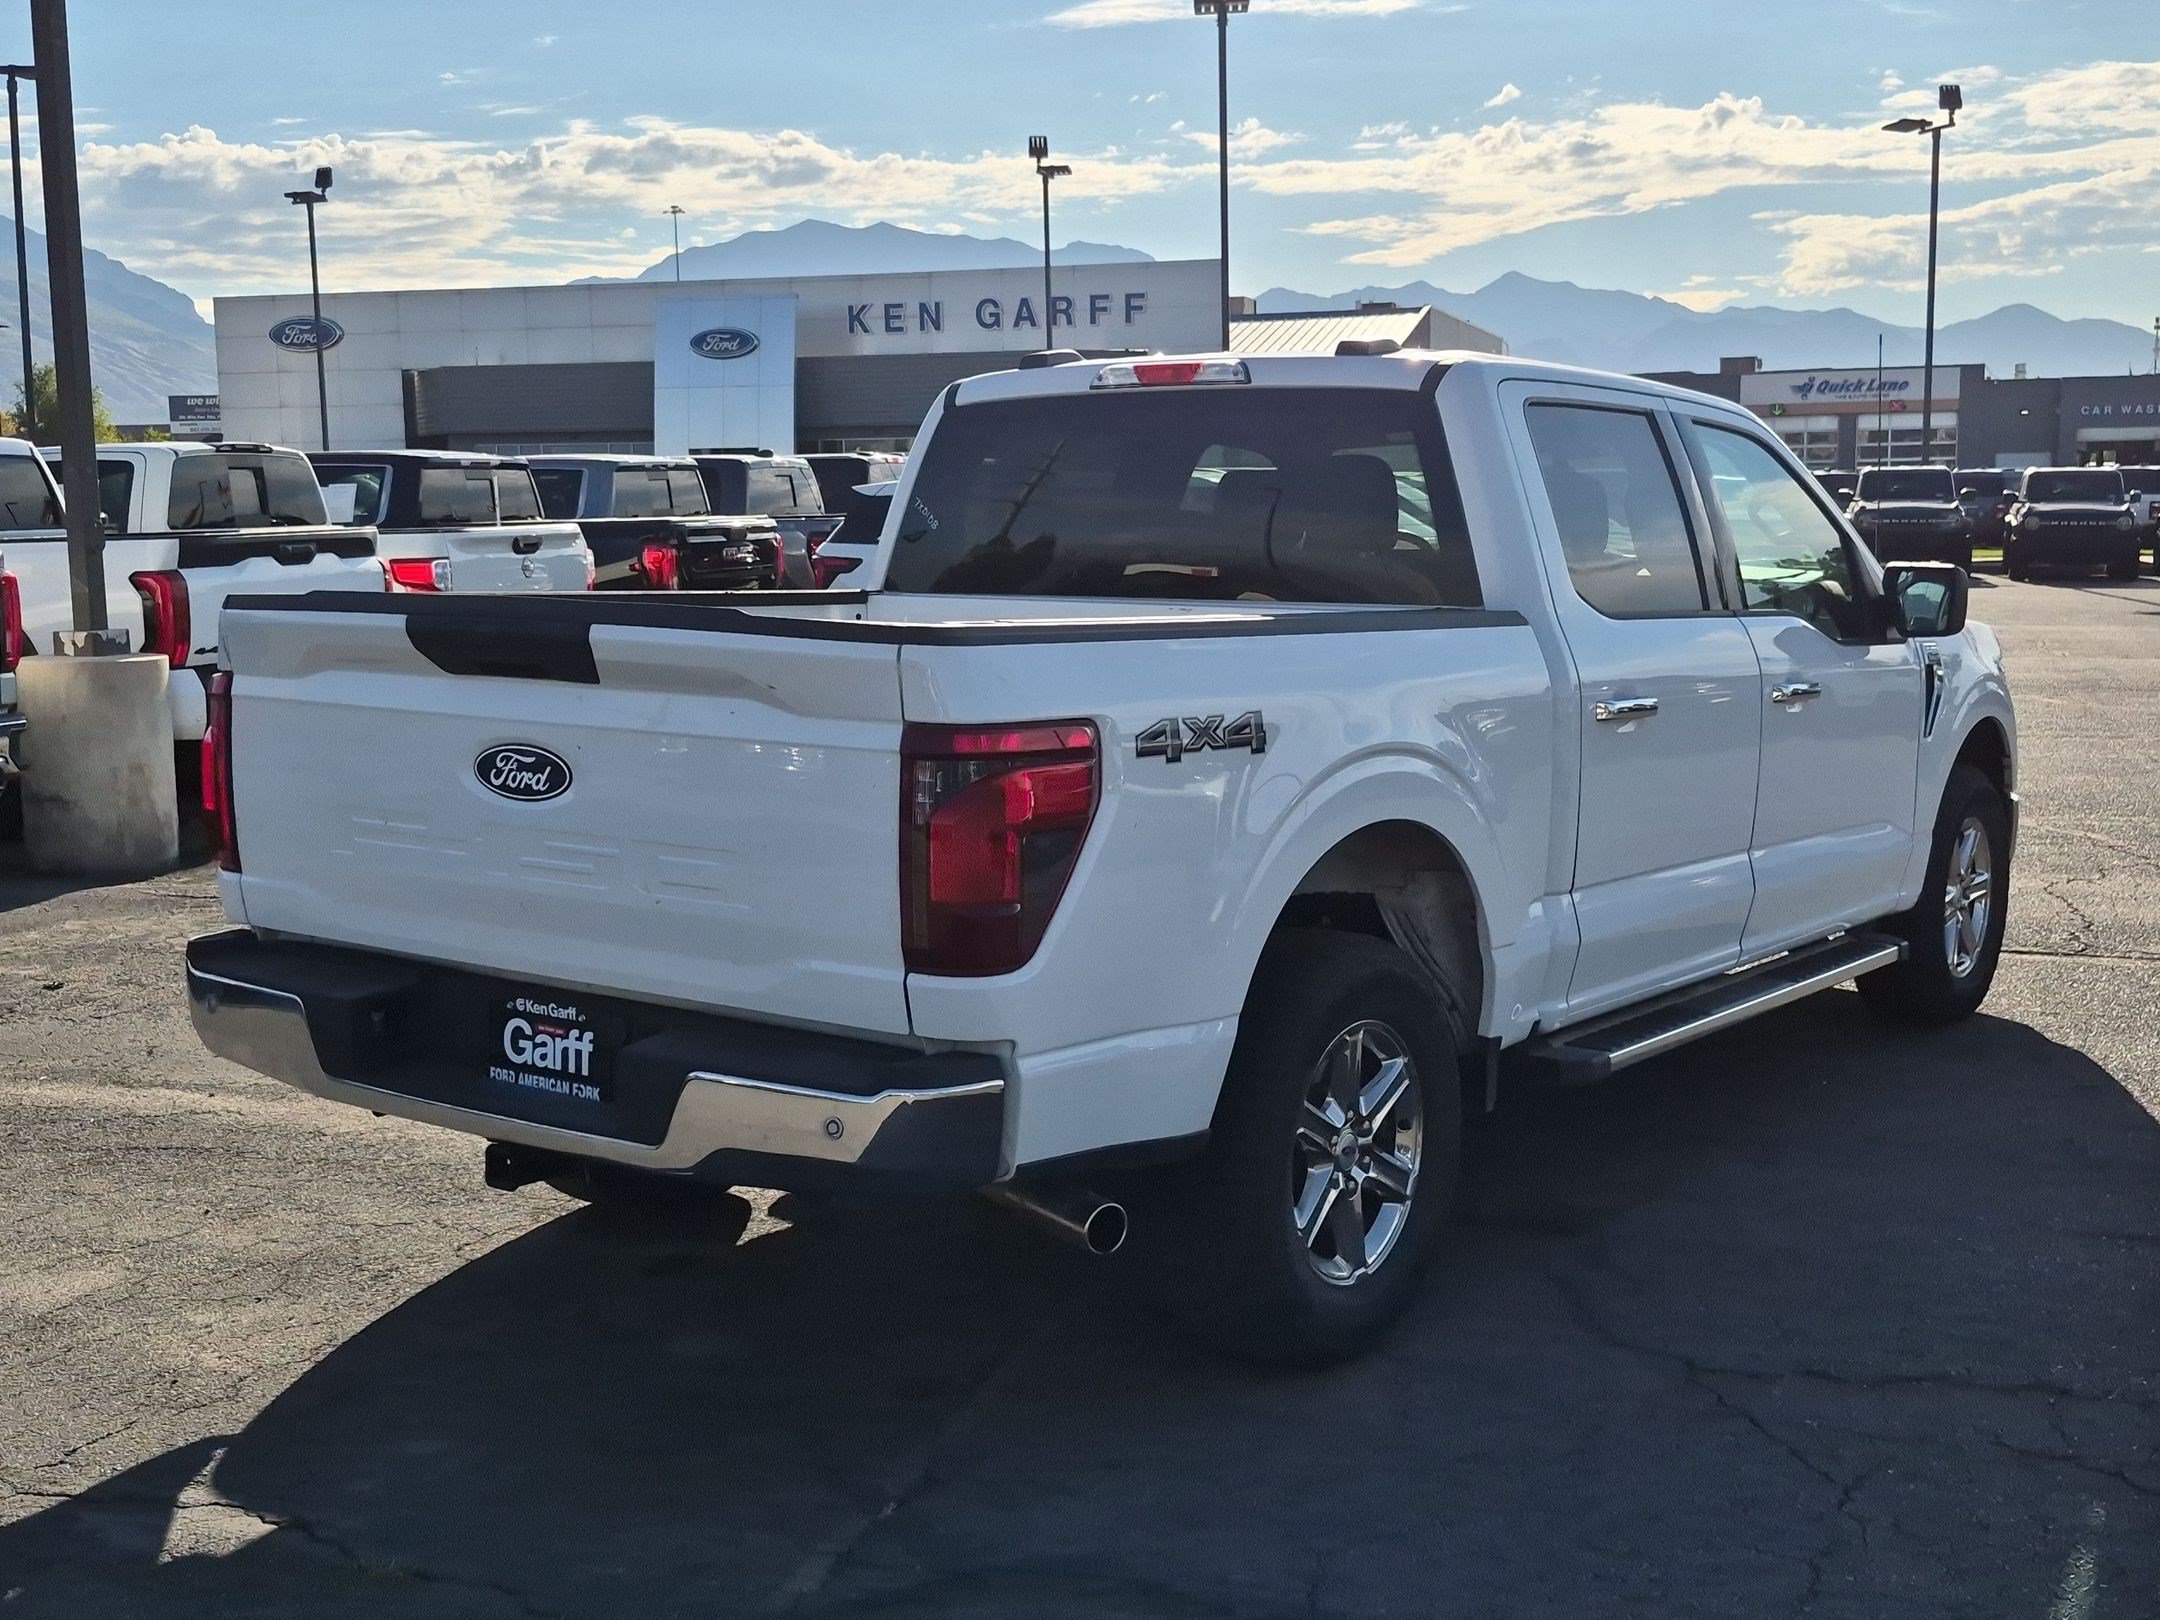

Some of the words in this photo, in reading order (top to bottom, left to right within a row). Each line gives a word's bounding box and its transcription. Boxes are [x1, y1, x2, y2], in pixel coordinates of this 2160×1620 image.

[848, 300, 942, 334] KEN
[975, 292, 1147, 329] GARFF
[702, 334, 741, 351] Ford
[1816, 379, 1865, 395] Quick
[2080, 405, 2112, 415] CAR
[2121, 404, 2160, 414] WAS
[490, 751, 550, 792] Ford
[526, 1000, 548, 1015] Ken
[548, 1003, 577, 1020] Garff
[504, 1018, 594, 1076] Garff
[490, 1066, 515, 1083] FORD
[518, 1073, 571, 1095] AMERICAN
[572, 1084, 600, 1101] FORK
